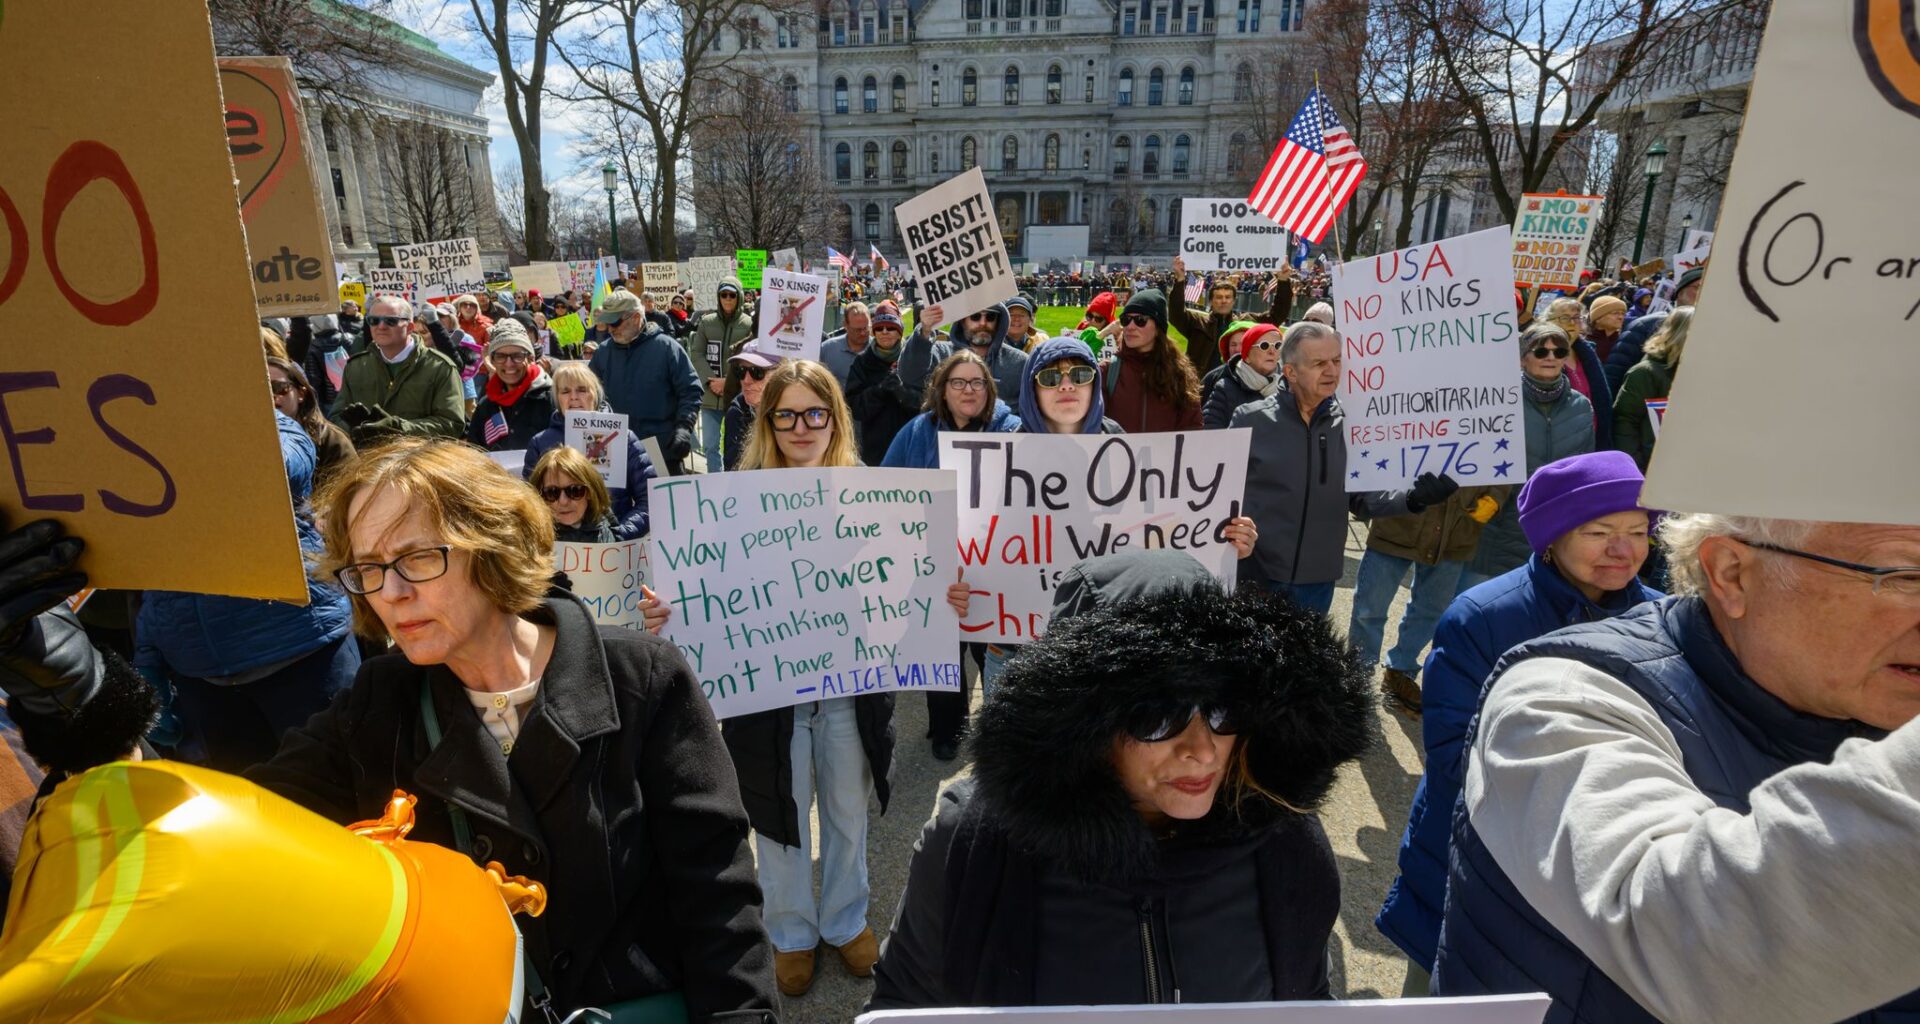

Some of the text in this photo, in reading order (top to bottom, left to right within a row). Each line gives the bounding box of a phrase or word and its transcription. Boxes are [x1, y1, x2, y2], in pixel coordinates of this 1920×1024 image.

[906, 193, 987, 250] RESIST!
[1210, 202, 1259, 218] 100+
[1541, 199, 1577, 214] NO
[1188, 224, 1285, 234] SCHOOL CHILDREN
[1521, 214, 1589, 234] KINGS
[438, 239, 471, 256] MAKE
[915, 222, 996, 278] RESIST!
[1183, 237, 1224, 253] Gone
[1530, 240, 1564, 255] NO
[1739, 180, 1851, 322] (Or
[250, 246, 322, 283] ate
[400, 254, 473, 271] ME REPEAT
[691, 258, 730, 270] REGIME
[1218, 253, 1279, 269] Forever
[1376, 243, 1454, 283] USA
[1512, 254, 1578, 272] IDIOTS
[1514, 269, 1573, 284] ITHER
[373, 283, 418, 291] MAKES US
[770, 277, 819, 294] NO KINGS!
[923, 250, 1004, 306] RESIST!
[1344, 278, 1481, 323] NO KINGS
[1346, 311, 1513, 360] NO TYRANTS
[1348, 365, 1385, 394] NO
[1365, 386, 1519, 417] AUTHORITARIANS
[573, 418, 621, 430] NO KINGS!
[1351, 413, 1516, 445] RESISTING SINCE
[952, 434, 1225, 512] The Only
[1401, 441, 1480, 478] 1776
[653, 479, 738, 530] The
[760, 479, 830, 513] most
[658, 513, 928, 572] Way people Give up
[957, 500, 1240, 566] Wall We need
[563, 539, 651, 573] DICTA
[622, 570, 645, 590] OR
[670, 553, 936, 627] their Power is
[582, 589, 643, 618] MOC
[959, 590, 1043, 640] Chr
[723, 608, 849, 650] thinking
[861, 594, 932, 628] they
[701, 636, 902, 699] on't have Any.
[895, 663, 961, 688] WALKER
